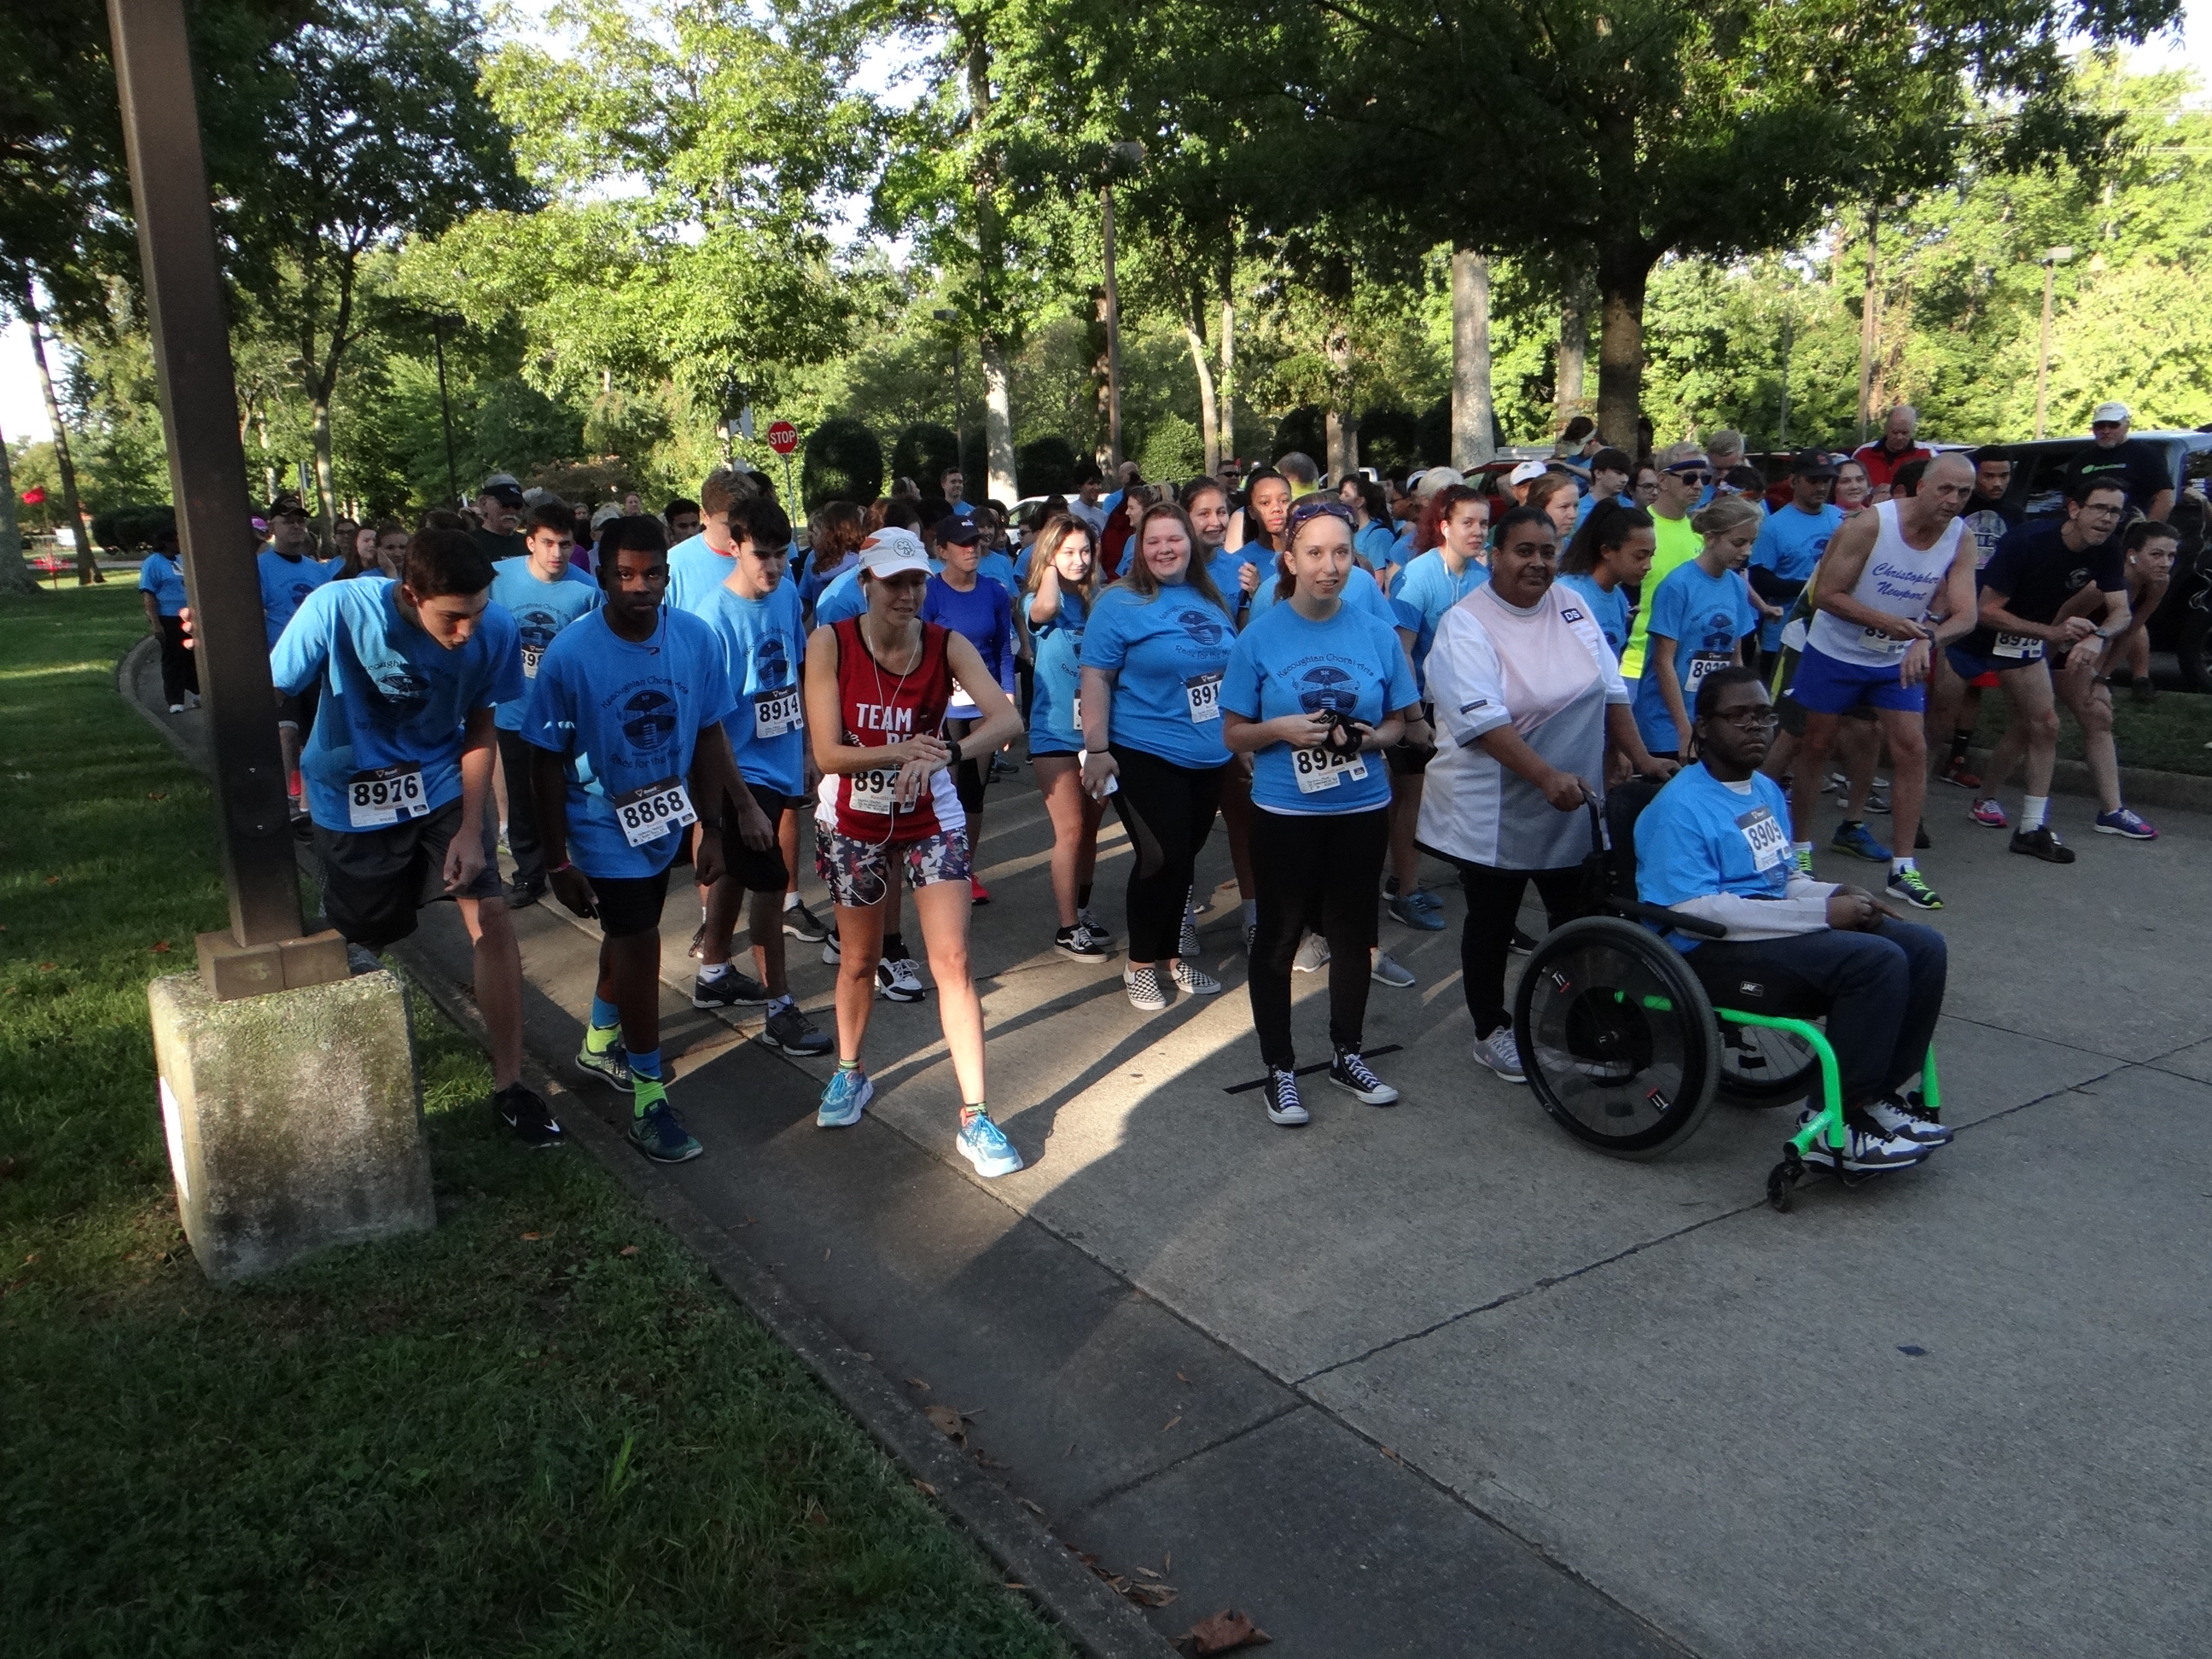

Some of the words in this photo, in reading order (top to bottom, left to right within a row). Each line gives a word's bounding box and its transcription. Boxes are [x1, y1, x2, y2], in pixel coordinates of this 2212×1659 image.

[770, 430, 795, 445] STOP
[1872, 562, 1939, 585] Christopher
[1877, 581, 1927, 601] Newport
[1564, 610, 1580, 620] DS
[1277, 655, 1324, 679] Kecoughtan
[1325, 653, 1356, 666] Choral
[760, 695, 799, 723] 8914
[856, 703, 912, 731] TEAM
[353, 775, 418, 806] 8976
[623, 790, 684, 830] 8868
[1748, 818, 1782, 851] 8909
